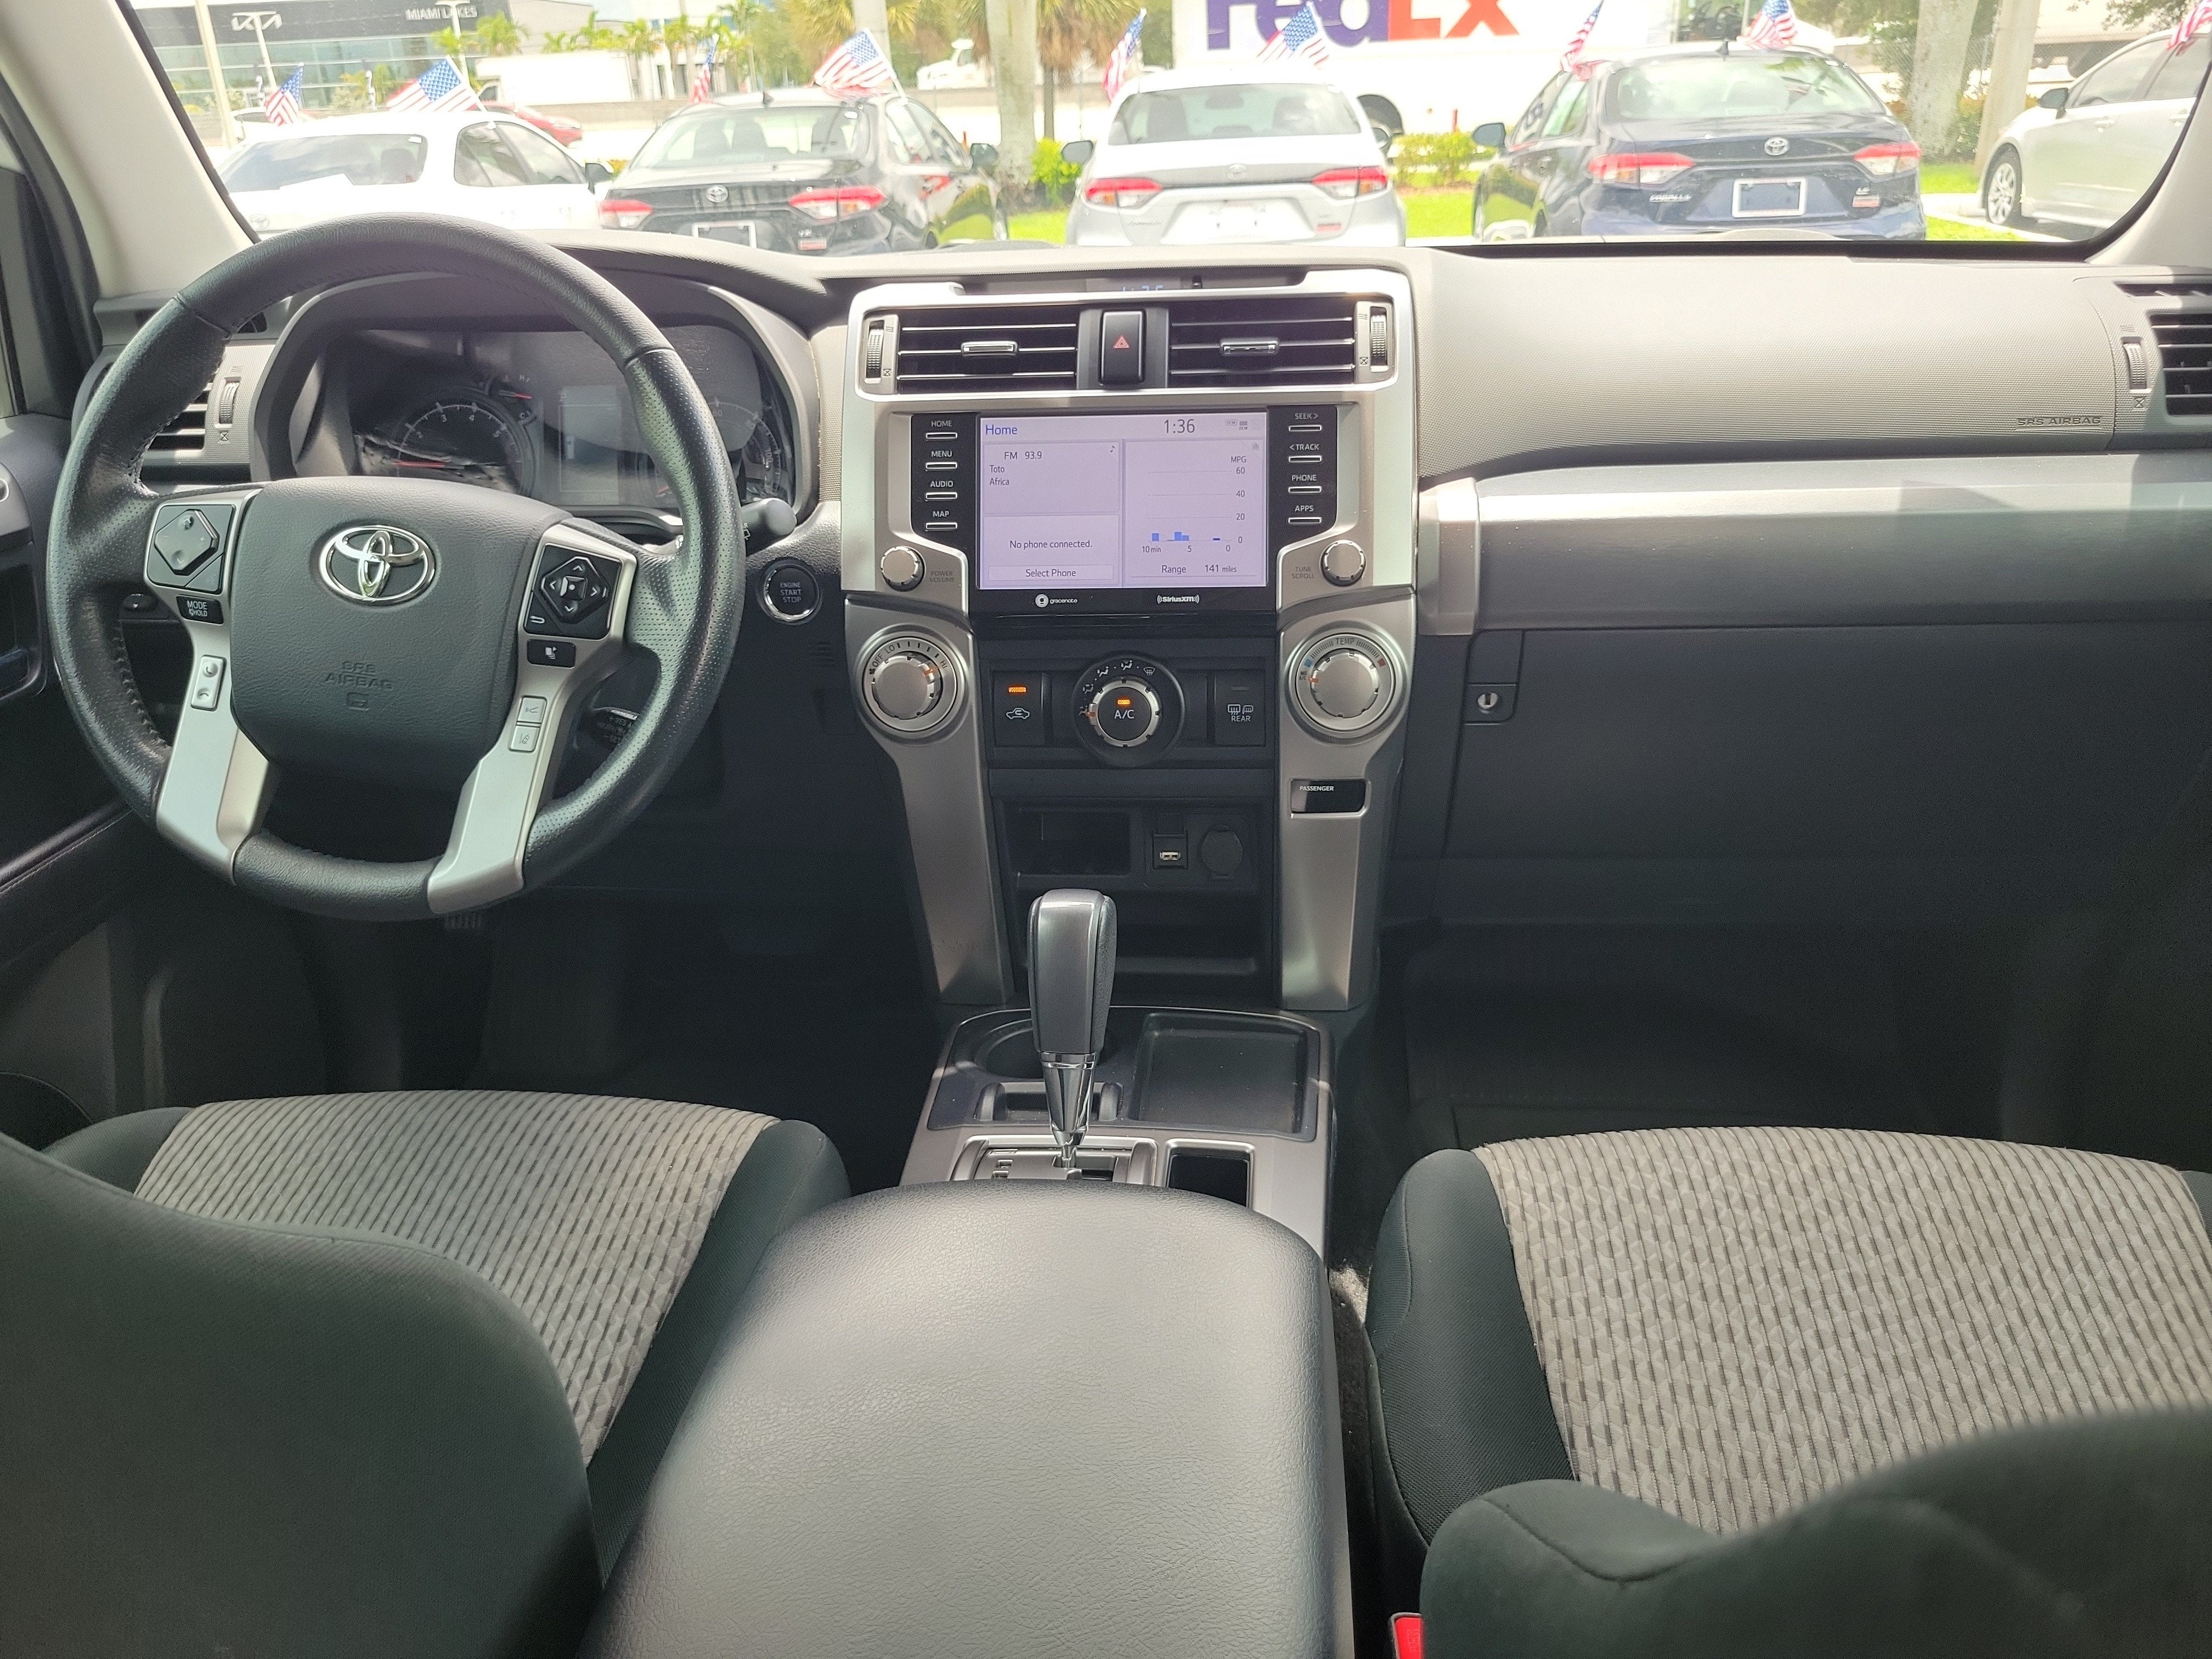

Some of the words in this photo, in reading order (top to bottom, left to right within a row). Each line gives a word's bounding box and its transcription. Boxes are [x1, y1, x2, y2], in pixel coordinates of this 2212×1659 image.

[405, 7, 441, 20] MIAMI
[441, 5, 478, 19] LKES
[2018, 417, 2044, 426] SRS
[2048, 416, 2101, 425] AIRBAG
[985, 425, 1018, 435] Home
[1164, 419, 1195, 434] 1:36
[1004, 452, 1018, 460] FM
[1025, 452, 1042, 460] 93.9
[1024, 540, 1048, 550] phone
[1049, 540, 1092, 548] connected.
[1051, 568, 1076, 577] Phone
[1161, 565, 1187, 574] Range
[187, 600, 207, 610] MODE
[885, 645, 895, 654] LO
[872, 653, 883, 667] OFF
[939, 660, 948, 669] HI
[1114, 709, 1135, 720] A/C
